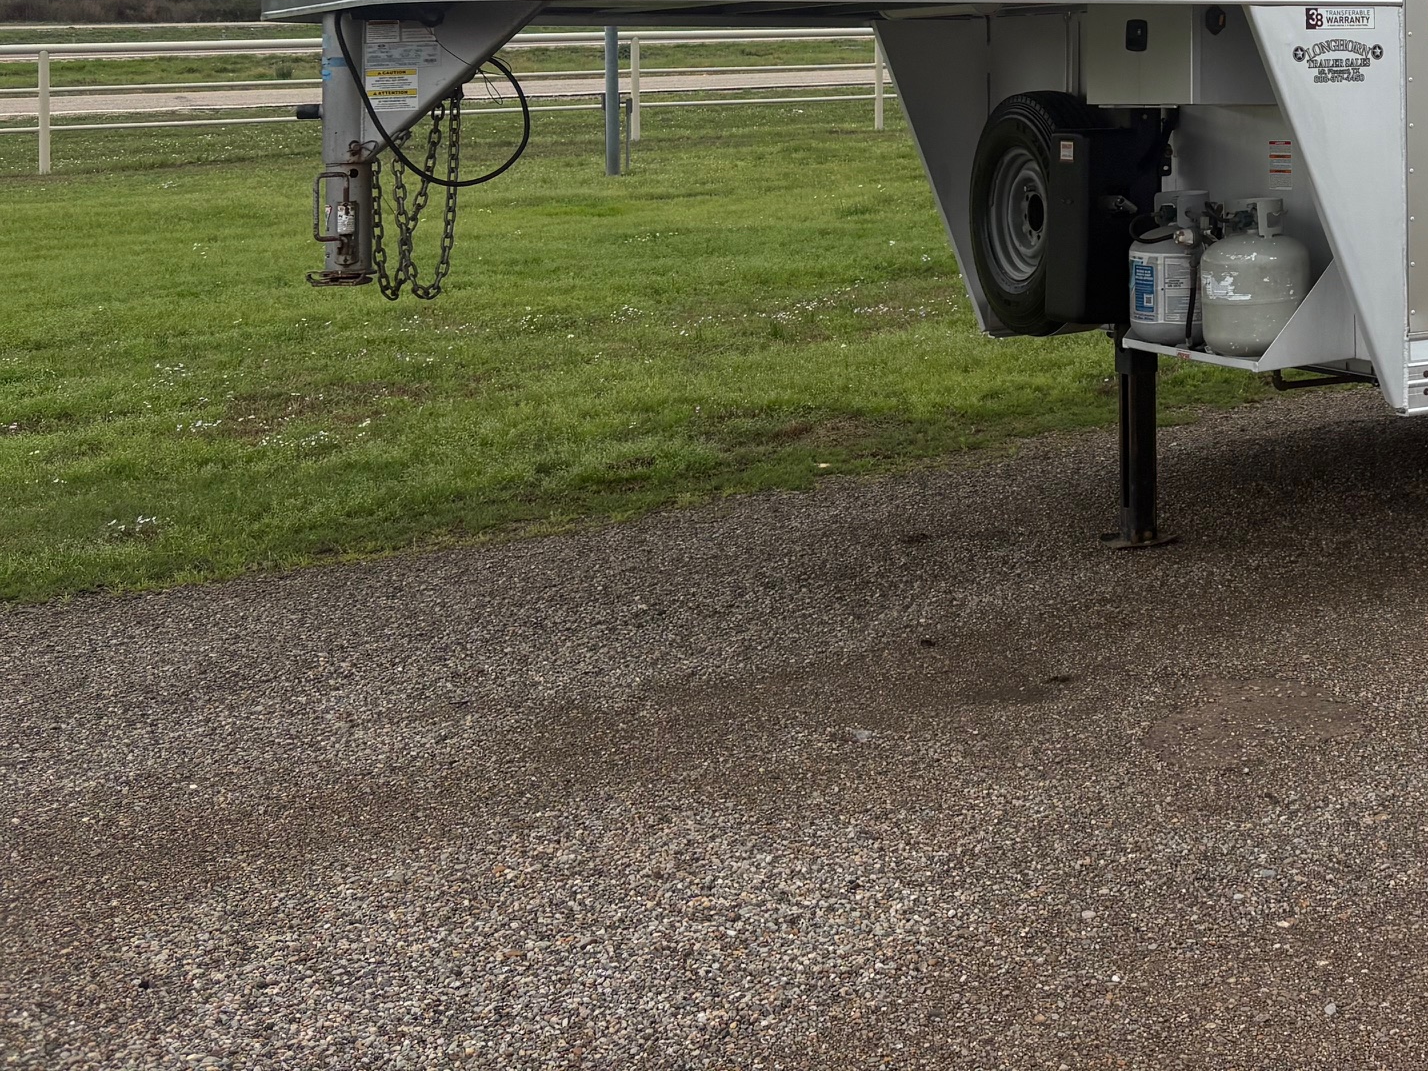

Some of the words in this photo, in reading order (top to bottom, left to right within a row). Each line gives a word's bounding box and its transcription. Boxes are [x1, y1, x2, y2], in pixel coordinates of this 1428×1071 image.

[1326, 16, 1370, 24] WARRANTY
[1305, 39, 1371, 60] LONGHORN
[1306, 59, 1344, 68] TRAILER
[1345, 58, 1371, 67] SALES
